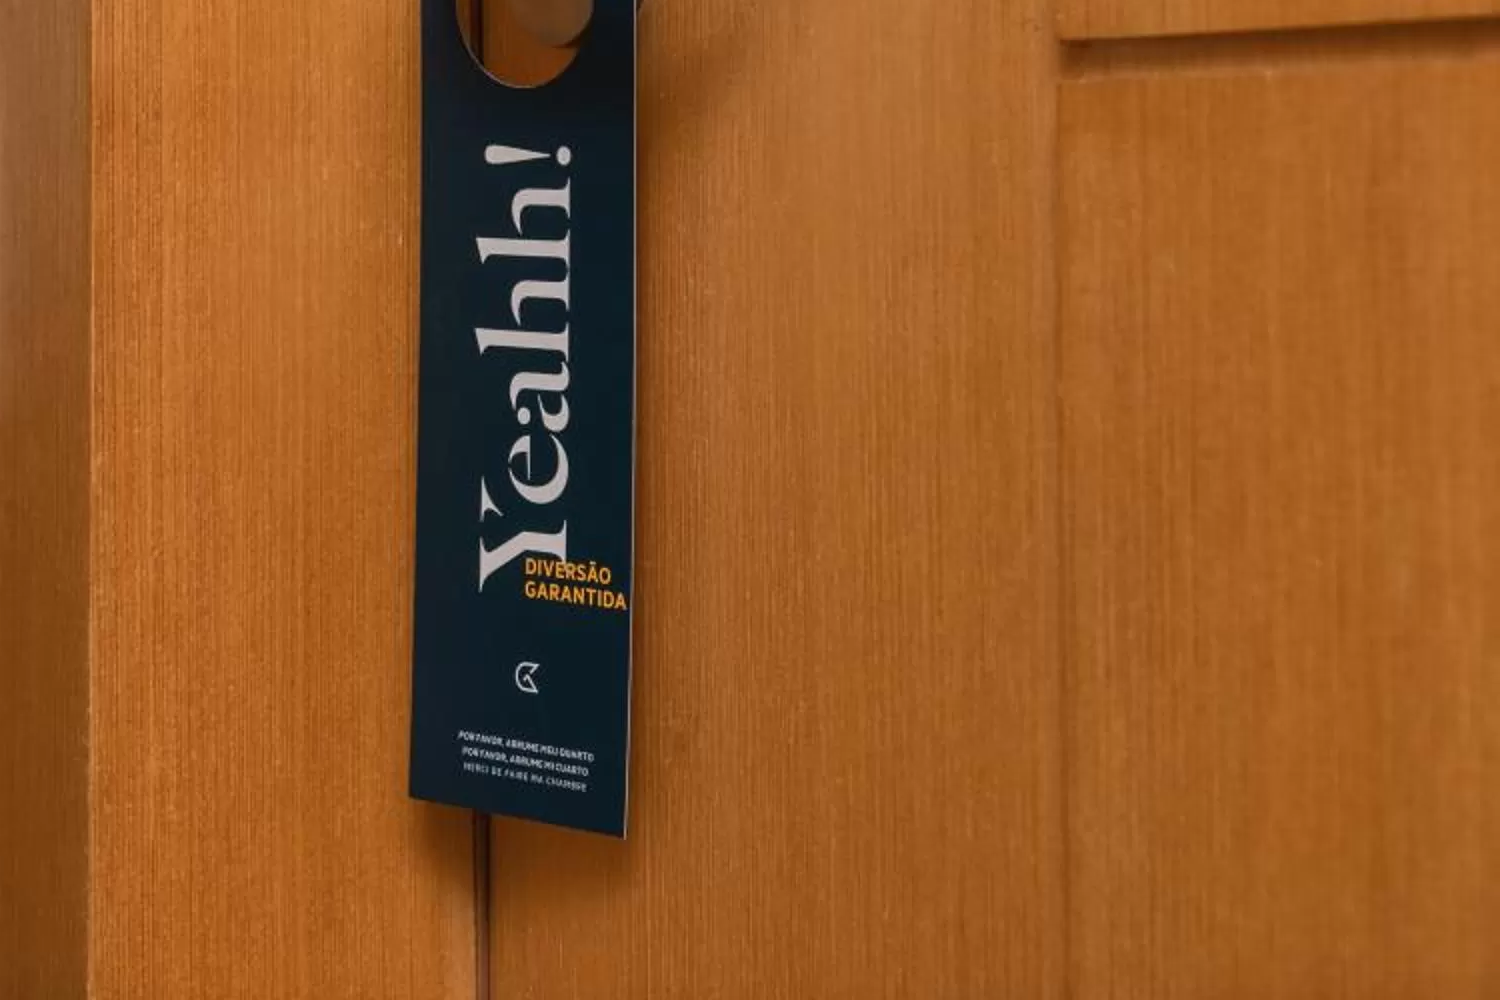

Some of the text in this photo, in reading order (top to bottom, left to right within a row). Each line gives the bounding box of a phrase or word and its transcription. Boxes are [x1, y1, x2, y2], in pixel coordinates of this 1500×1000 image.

[475, 143, 573, 593] Yeahh!
[525, 557, 611, 585] DIVERSÃO
[525, 581, 627, 610] GARANTIDA
